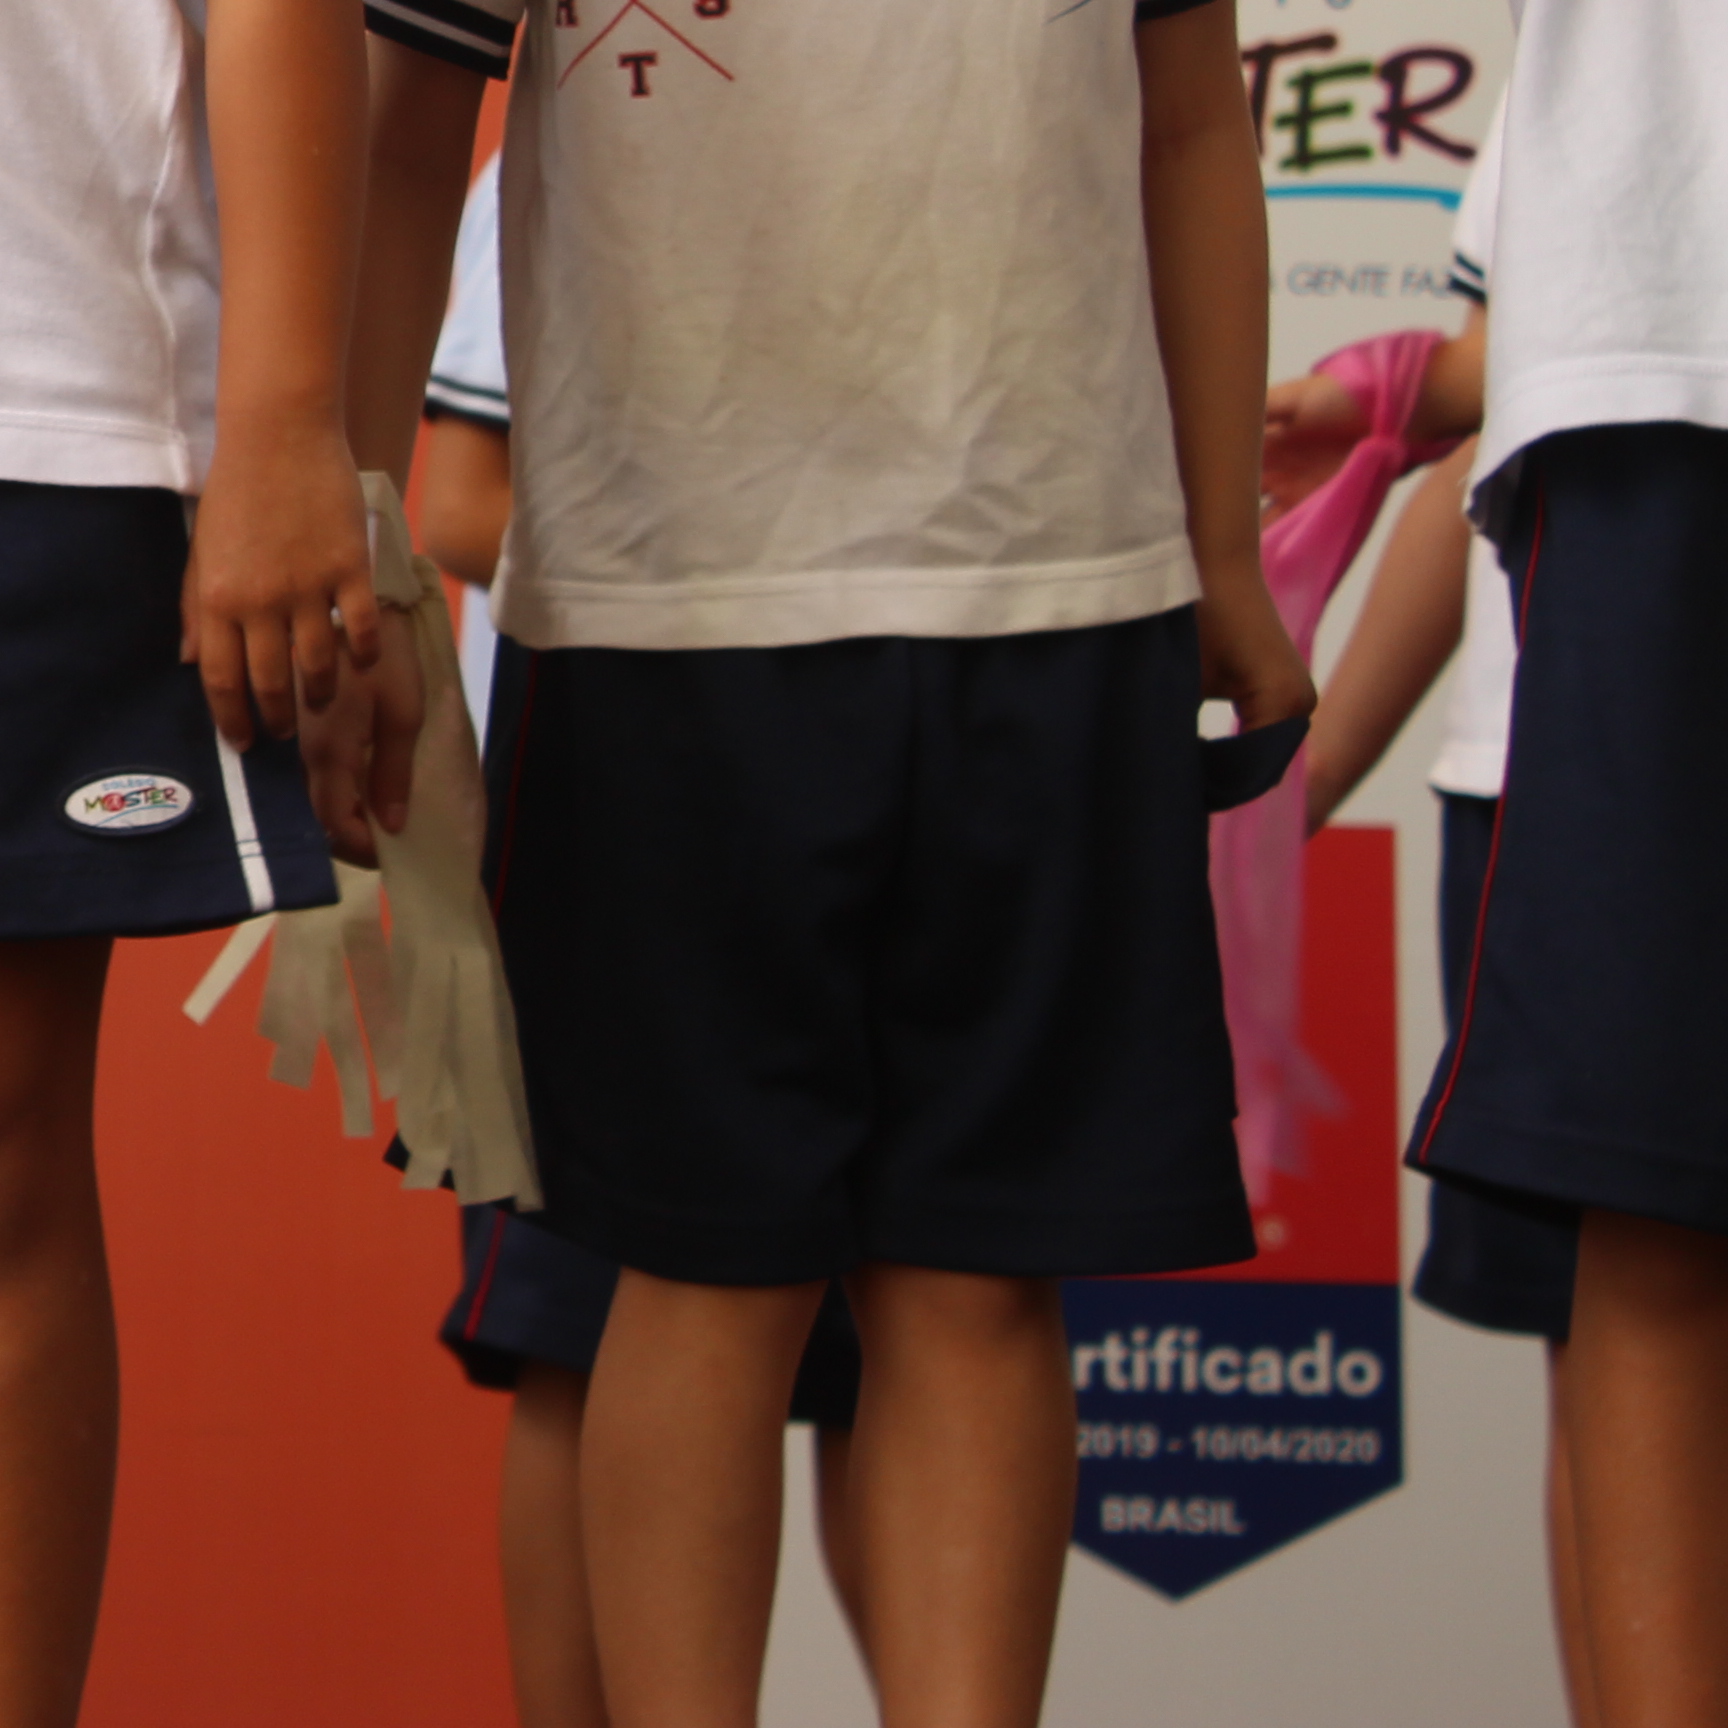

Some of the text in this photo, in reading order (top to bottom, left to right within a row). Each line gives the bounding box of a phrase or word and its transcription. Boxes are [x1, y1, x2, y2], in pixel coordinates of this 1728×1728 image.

[618, 52, 658, 98] T
[1242, 29, 1478, 173] TER
[1075, 1327, 1384, 1398] rtificado
[1192, 1427, 1381, 1464] 10/04/2020
[1100, 1494, 1248, 1538] BRASIL
